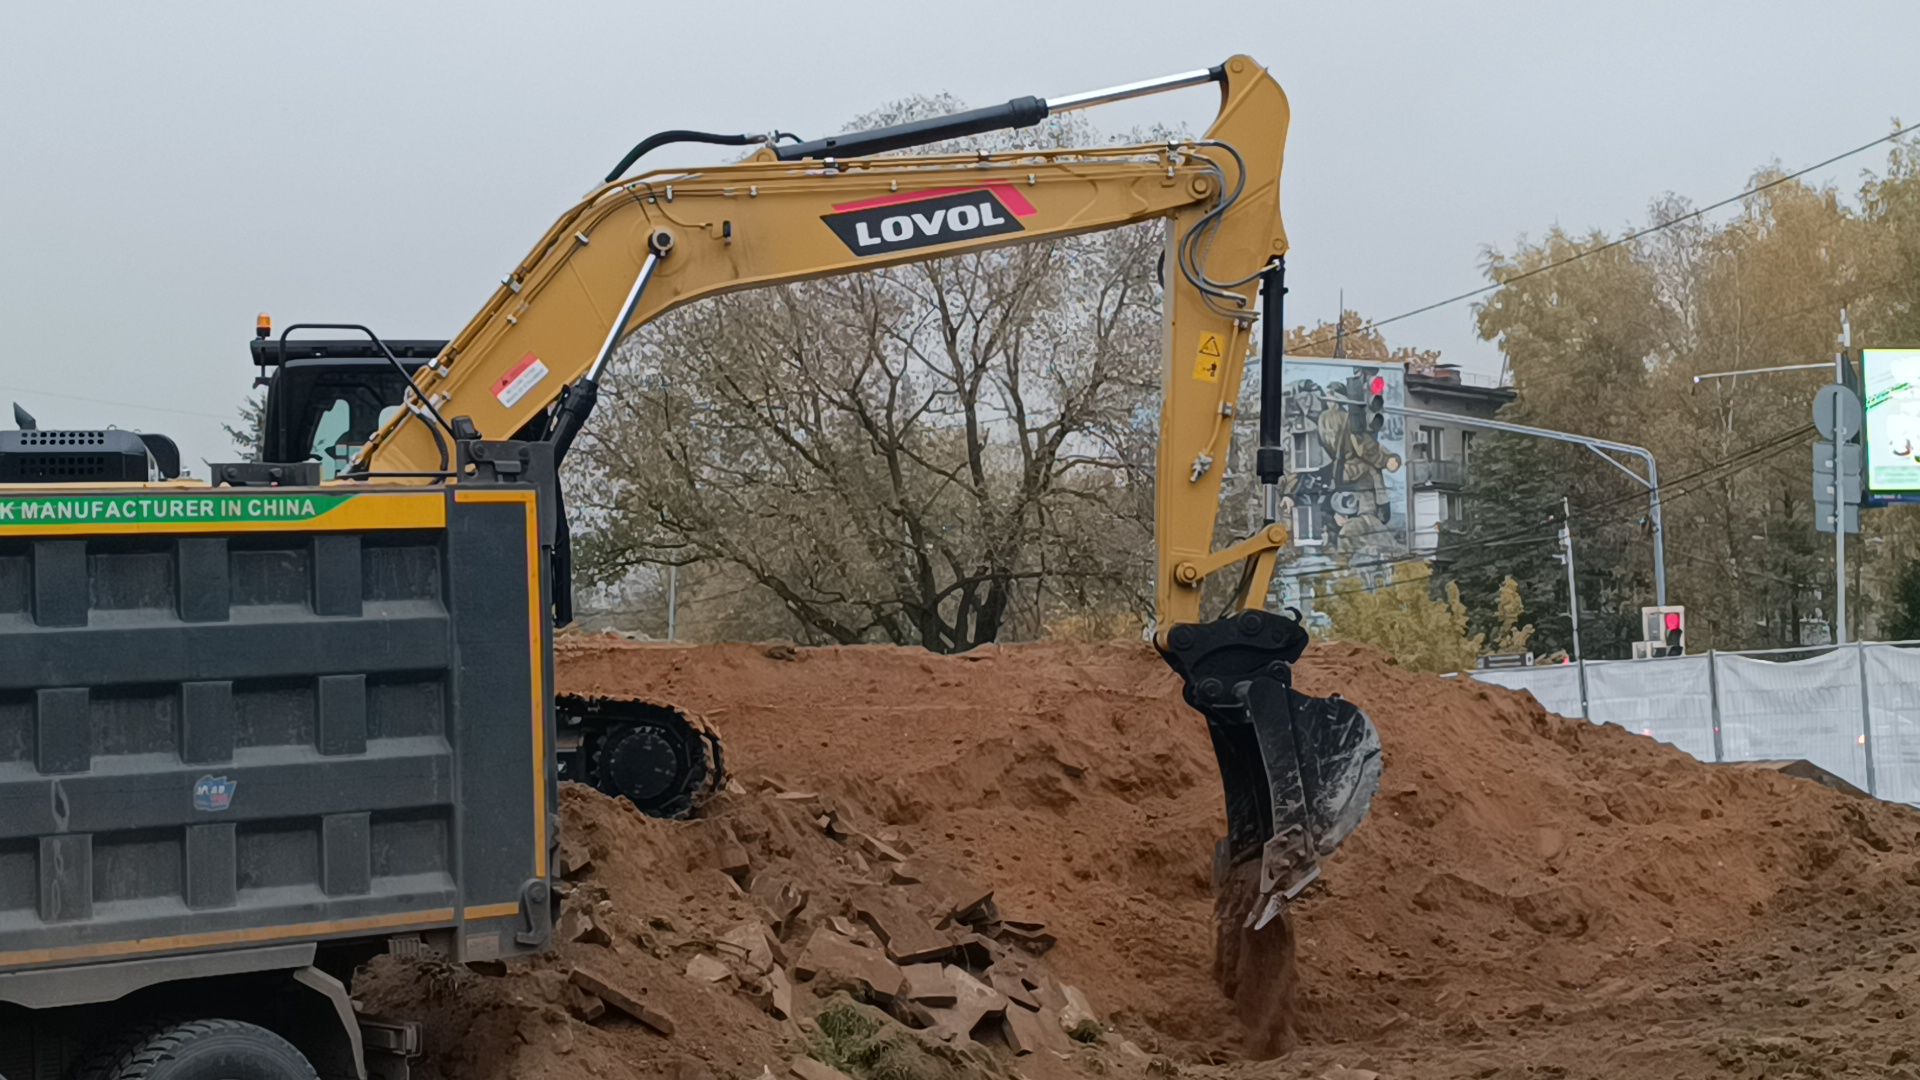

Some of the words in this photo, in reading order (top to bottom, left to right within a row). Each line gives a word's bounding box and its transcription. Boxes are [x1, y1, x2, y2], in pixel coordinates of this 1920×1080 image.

[855, 202, 1005, 246] LOVOL
[21, 500, 214, 519] MANUFACTURER
[221, 499, 241, 516] IN
[248, 499, 316, 516] CHINA
